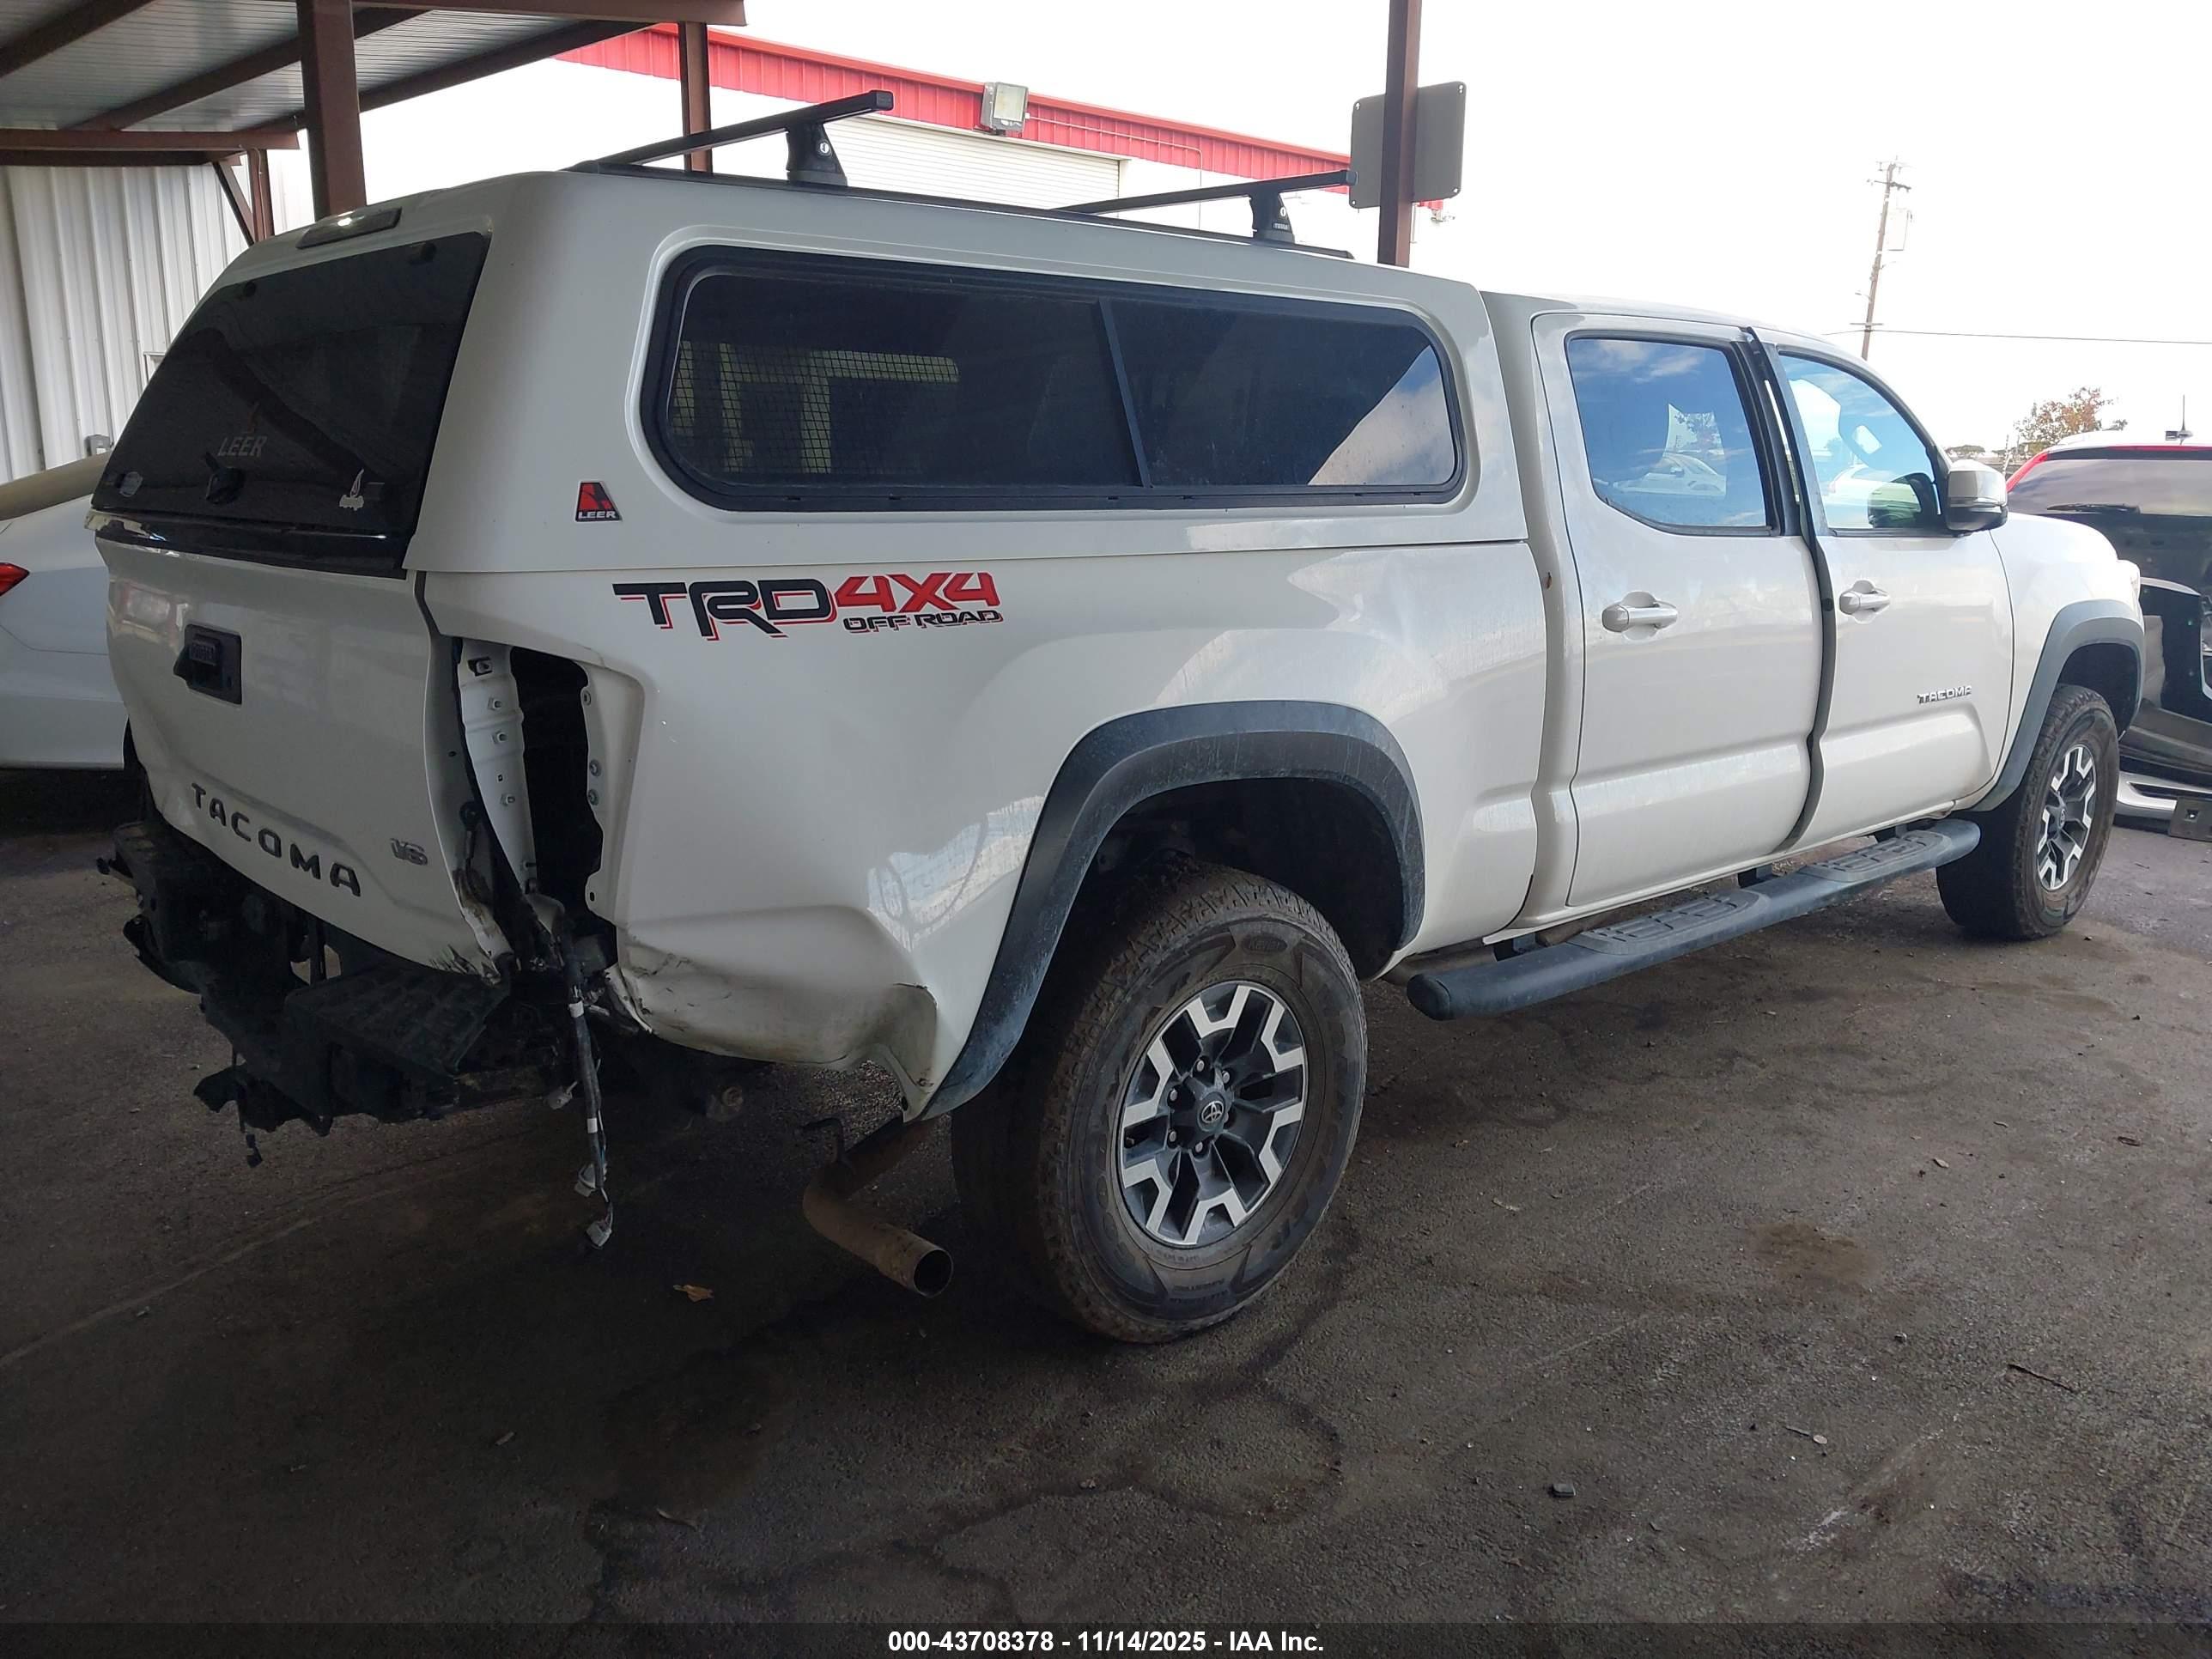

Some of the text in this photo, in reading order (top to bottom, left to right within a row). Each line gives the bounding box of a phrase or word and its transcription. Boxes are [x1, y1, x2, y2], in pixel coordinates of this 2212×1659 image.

[217, 435, 269, 457] LEER
[578, 510, 617, 520] LEER
[611, 572, 1002, 641] TRD 4X4
[843, 610, 1003, 634] OFF ROAD
[1917, 684, 1972, 705] TACOMA
[191, 782, 362, 897] TACOMA
[390, 837, 428, 866] V6
